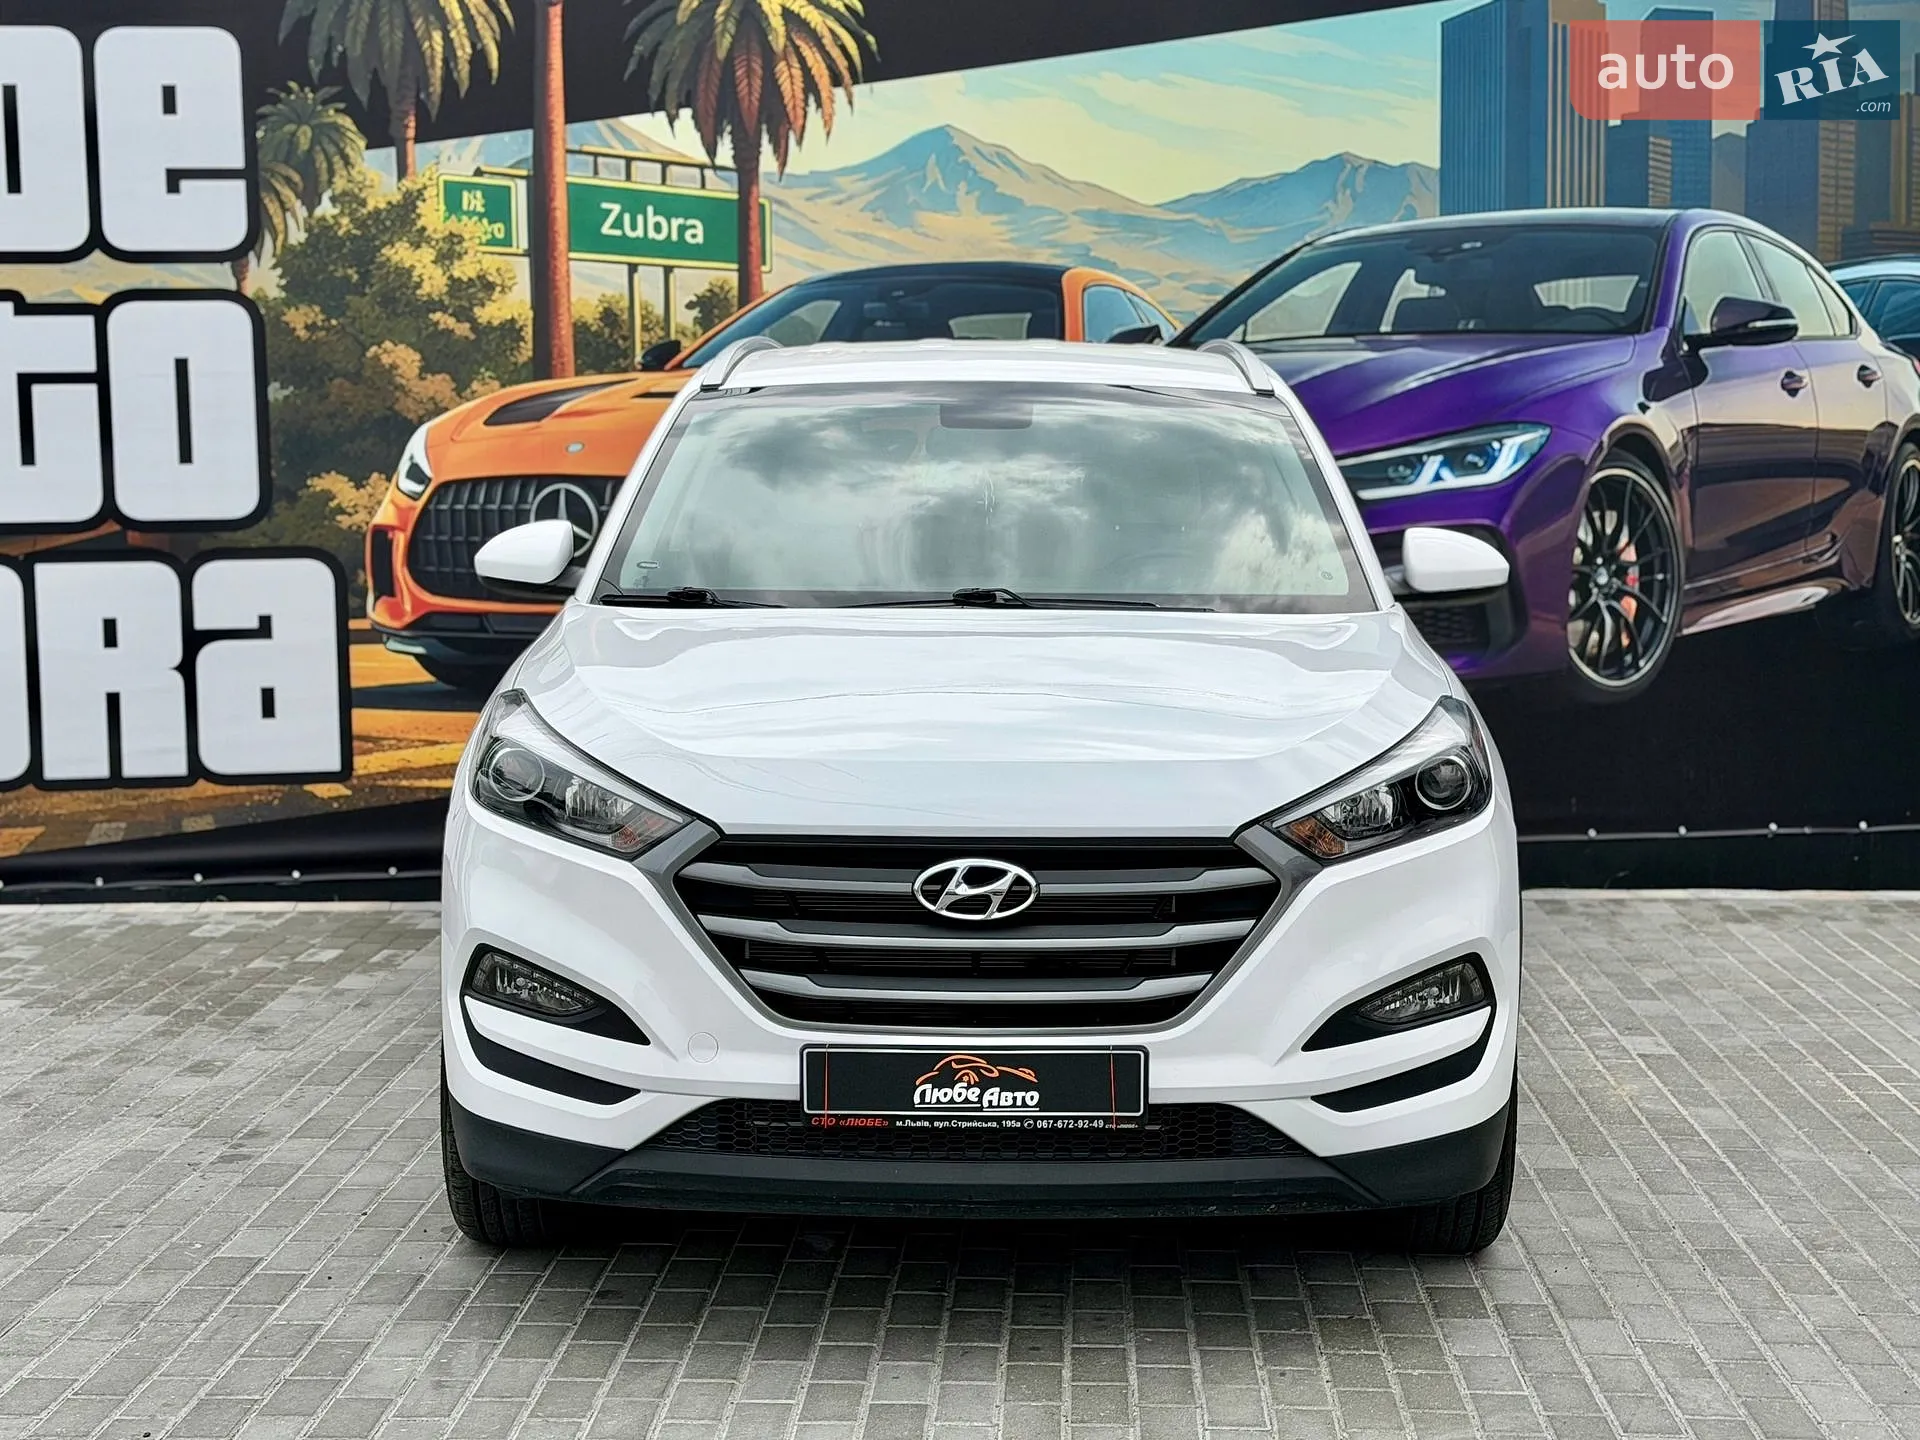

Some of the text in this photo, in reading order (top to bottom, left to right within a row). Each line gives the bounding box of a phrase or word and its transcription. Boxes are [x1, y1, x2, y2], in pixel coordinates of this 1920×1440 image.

[600, 202, 704, 244] Zubra
[913, 1083, 981, 1105] Любе
[811, 1117, 836, 1127] СТО
[1036, 1119, 1104, 1129] 067-672-92-49
